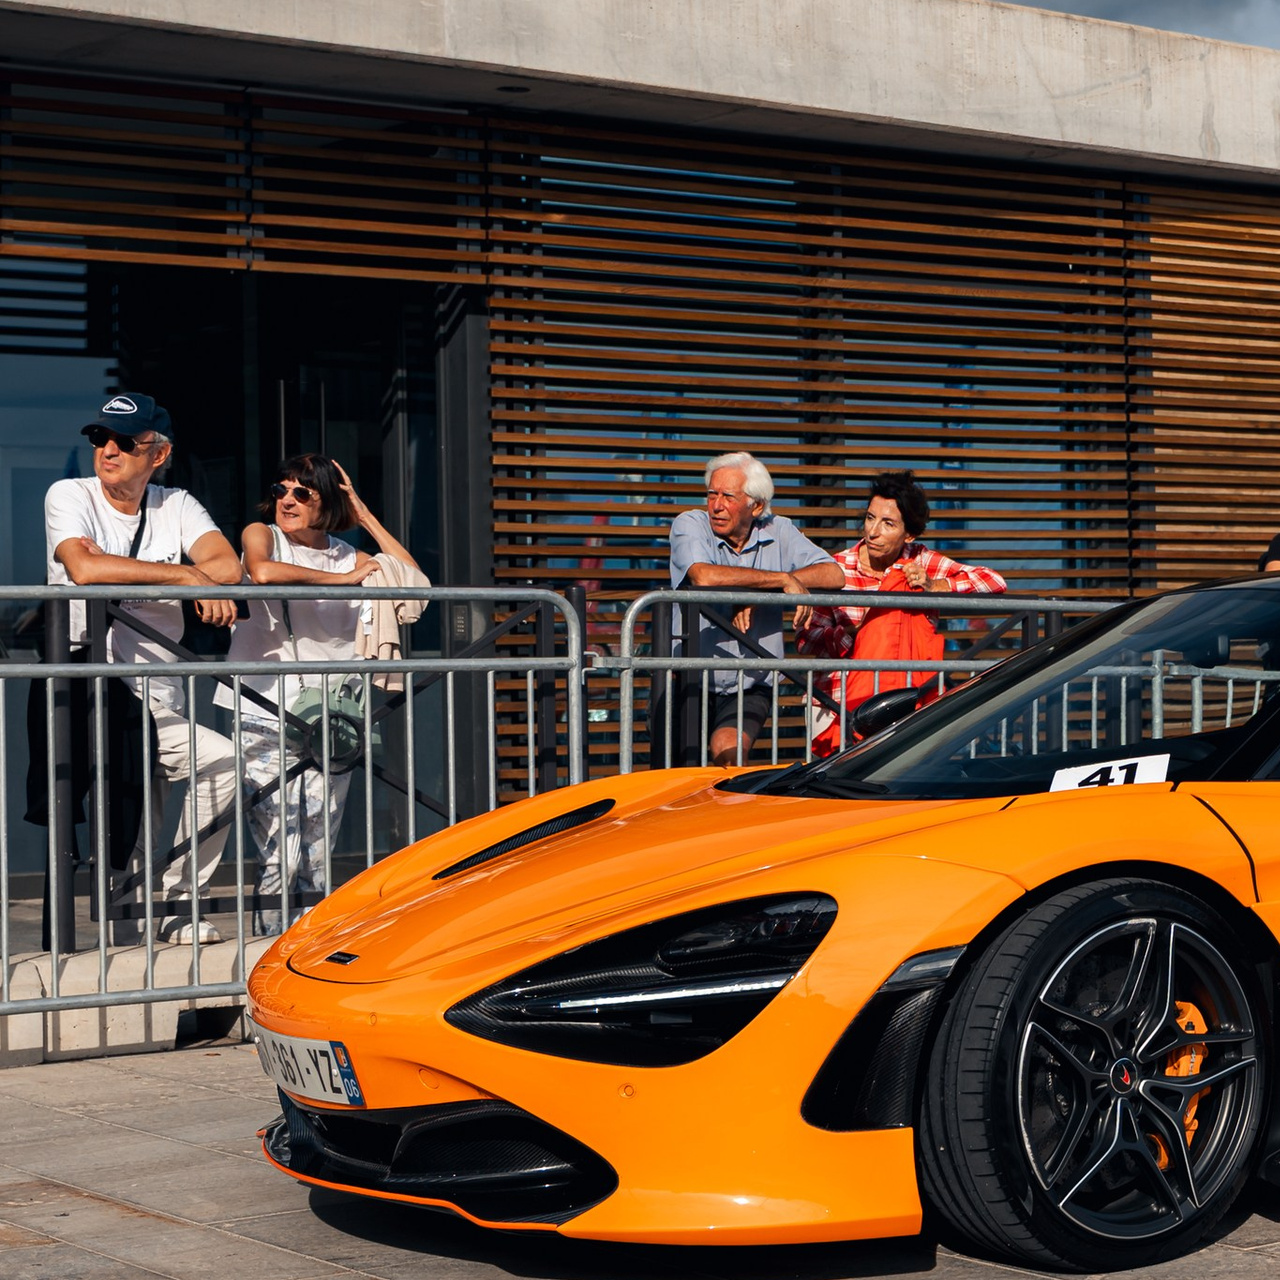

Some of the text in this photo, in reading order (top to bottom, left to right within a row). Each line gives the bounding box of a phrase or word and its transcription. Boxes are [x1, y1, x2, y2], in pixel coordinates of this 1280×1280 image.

[1077, 762, 1139, 788] 41
[256, 1031, 343, 1095] -361-YZ
[343, 1078, 360, 1098] 06
